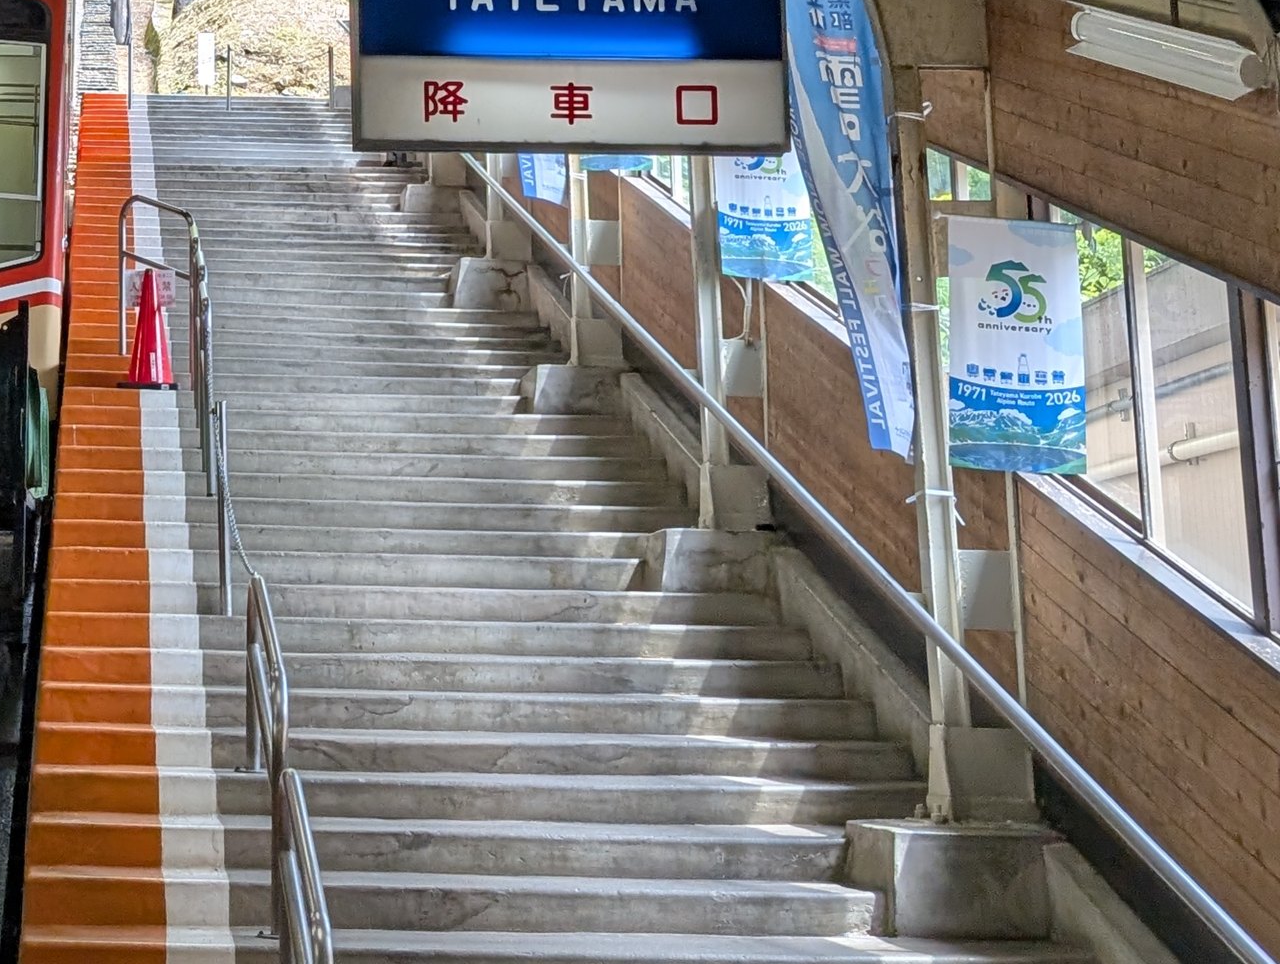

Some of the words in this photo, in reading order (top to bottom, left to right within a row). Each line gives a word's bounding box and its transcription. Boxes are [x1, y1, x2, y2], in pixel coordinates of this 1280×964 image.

[734, 173, 787, 182] anniversary
[723, 216, 742, 229] 1971
[783, 220, 807, 232] 2026
[977, 322, 1052, 336] anniversary
[957, 382, 986, 402] 1971
[1045, 390, 1081, 406] 2026
